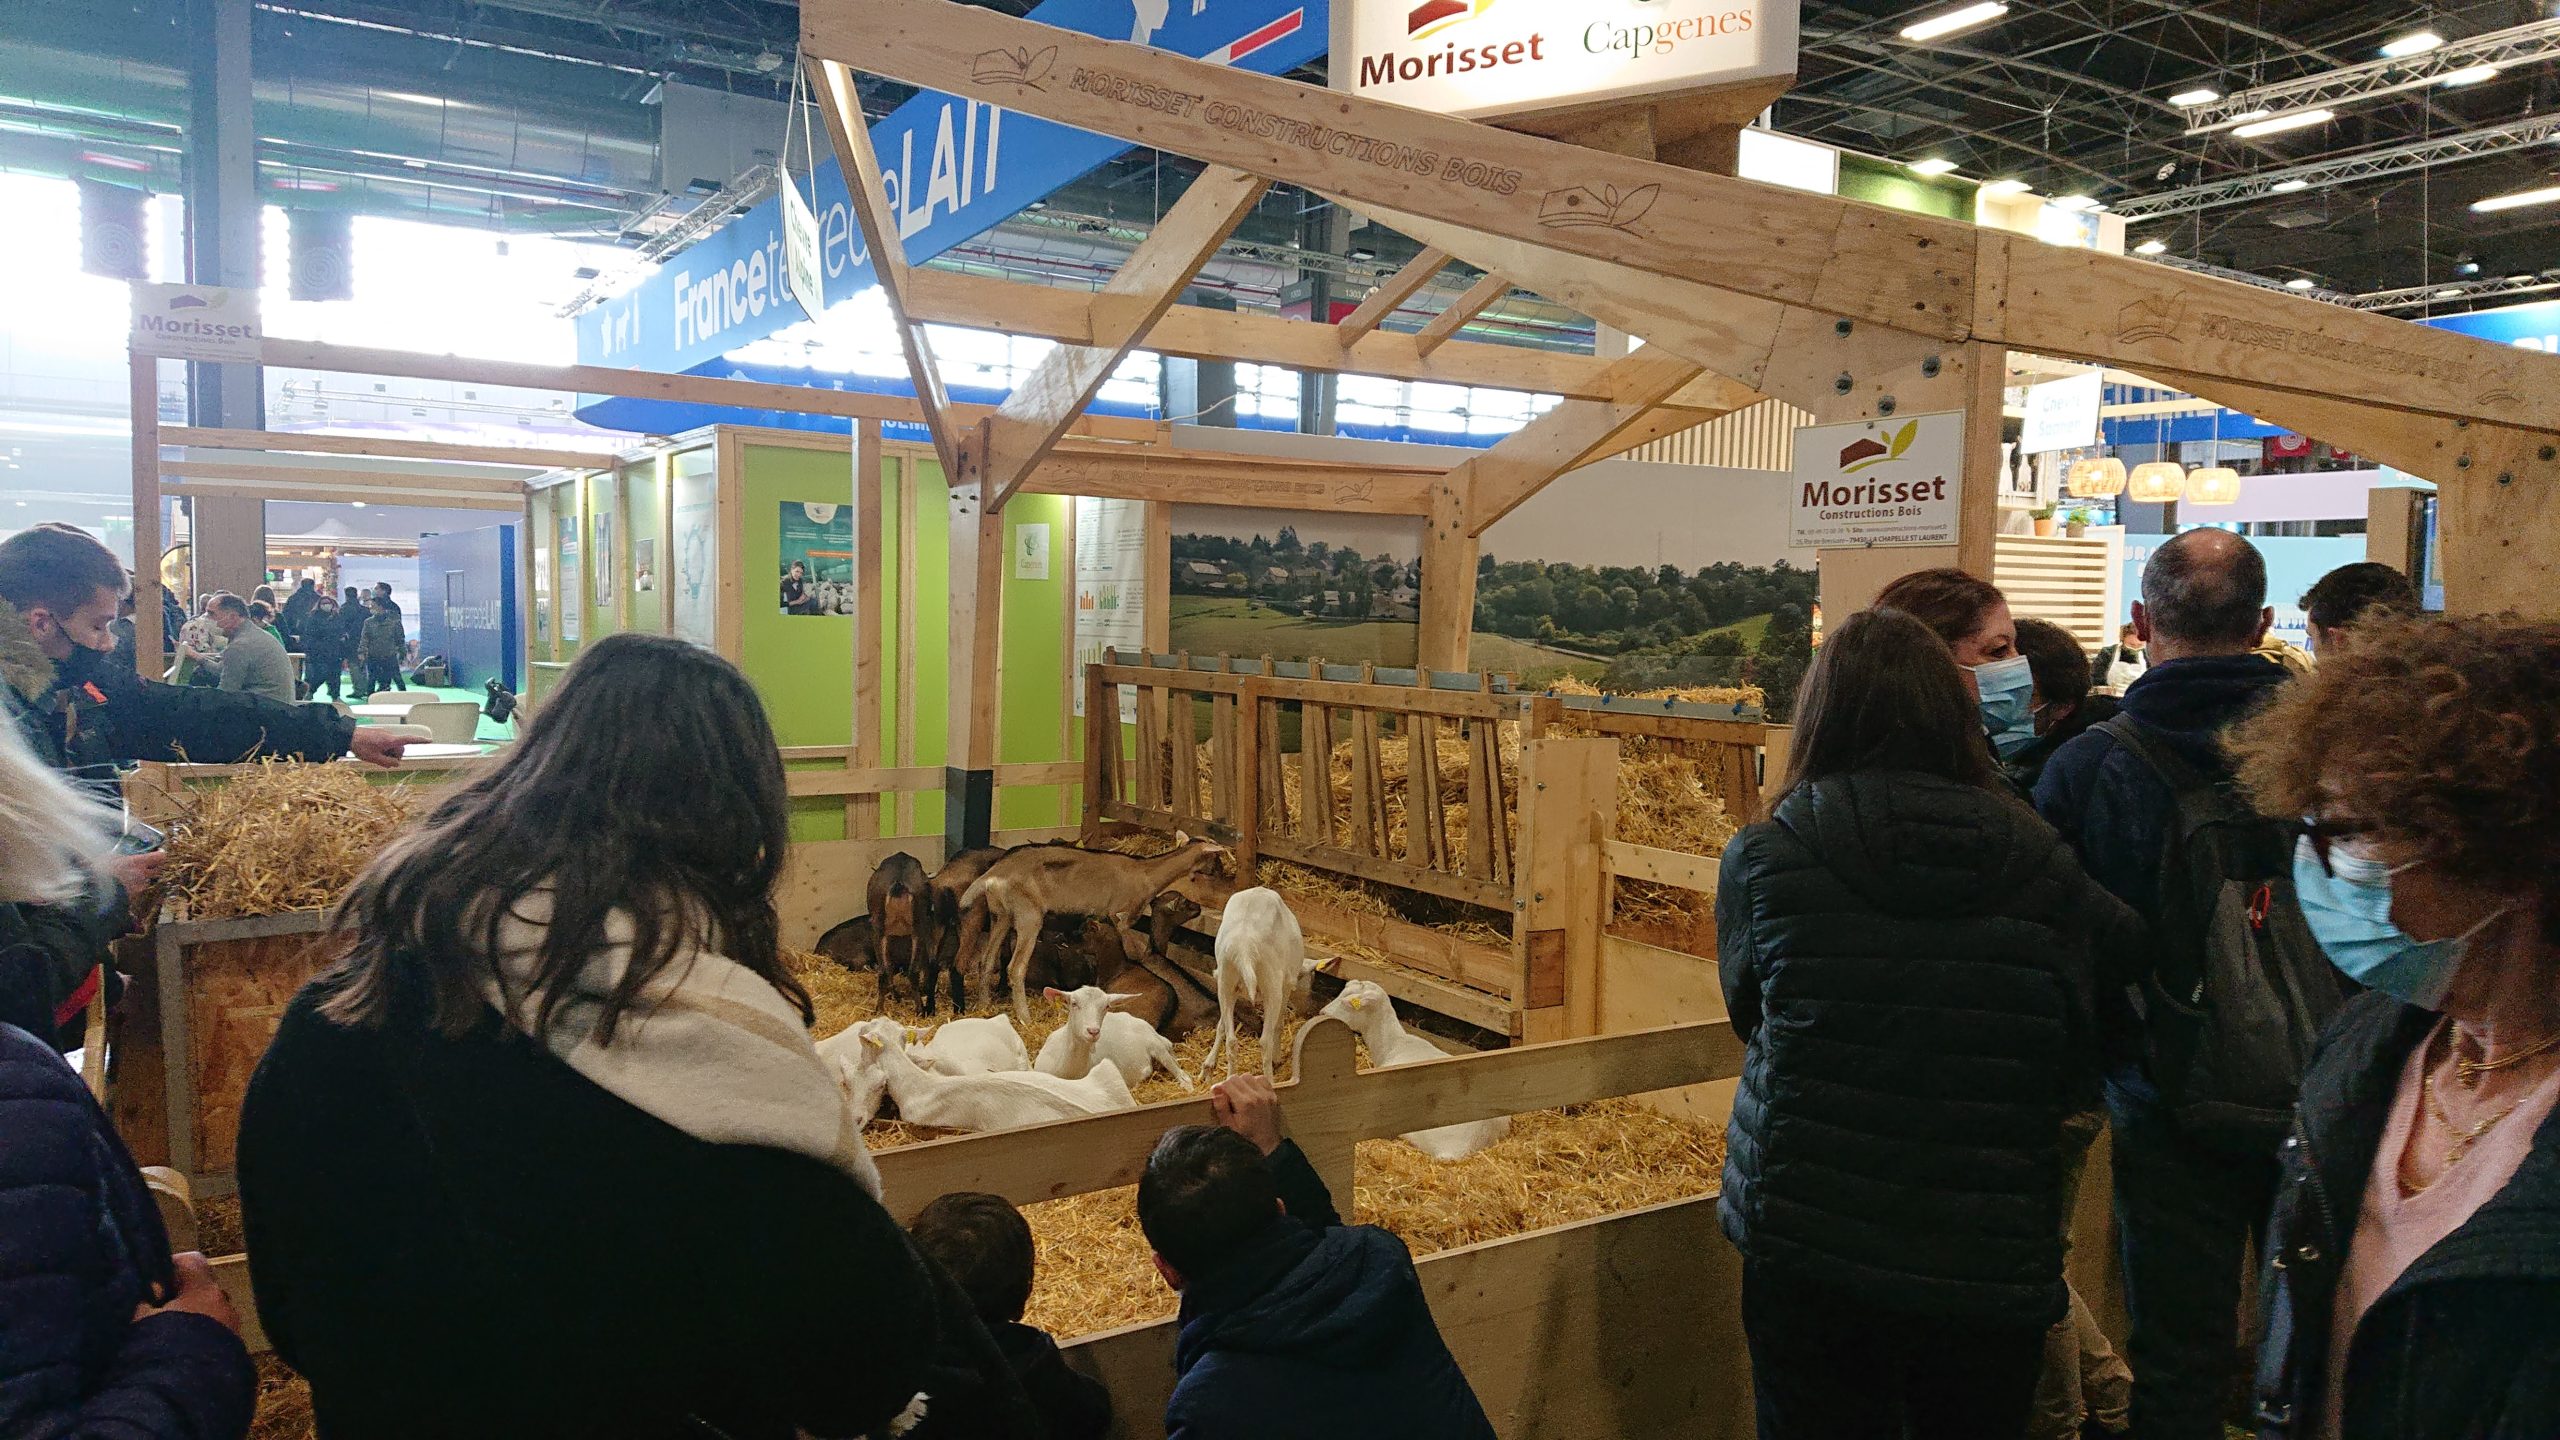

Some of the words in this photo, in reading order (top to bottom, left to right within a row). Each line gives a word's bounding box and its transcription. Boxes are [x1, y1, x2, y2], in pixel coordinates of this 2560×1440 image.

[1582, 8, 1753, 60] Capgenes
[1359, 32, 1545, 88] Morisset
[1069, 67, 1205, 119] MORISSET
[1203, 100, 1439, 176] CONSTRUCTIONS
[1440, 156, 1523, 195] BOIS
[140, 314, 253, 339] Morisset
[2199, 312, 2295, 353] MORISSET
[1802, 475, 1946, 508] Morisset
[1819, 507, 1895, 521] Constructions
[1897, 505, 1923, 518] Bois
[1878, 535, 1908, 543] CHAPELLE
